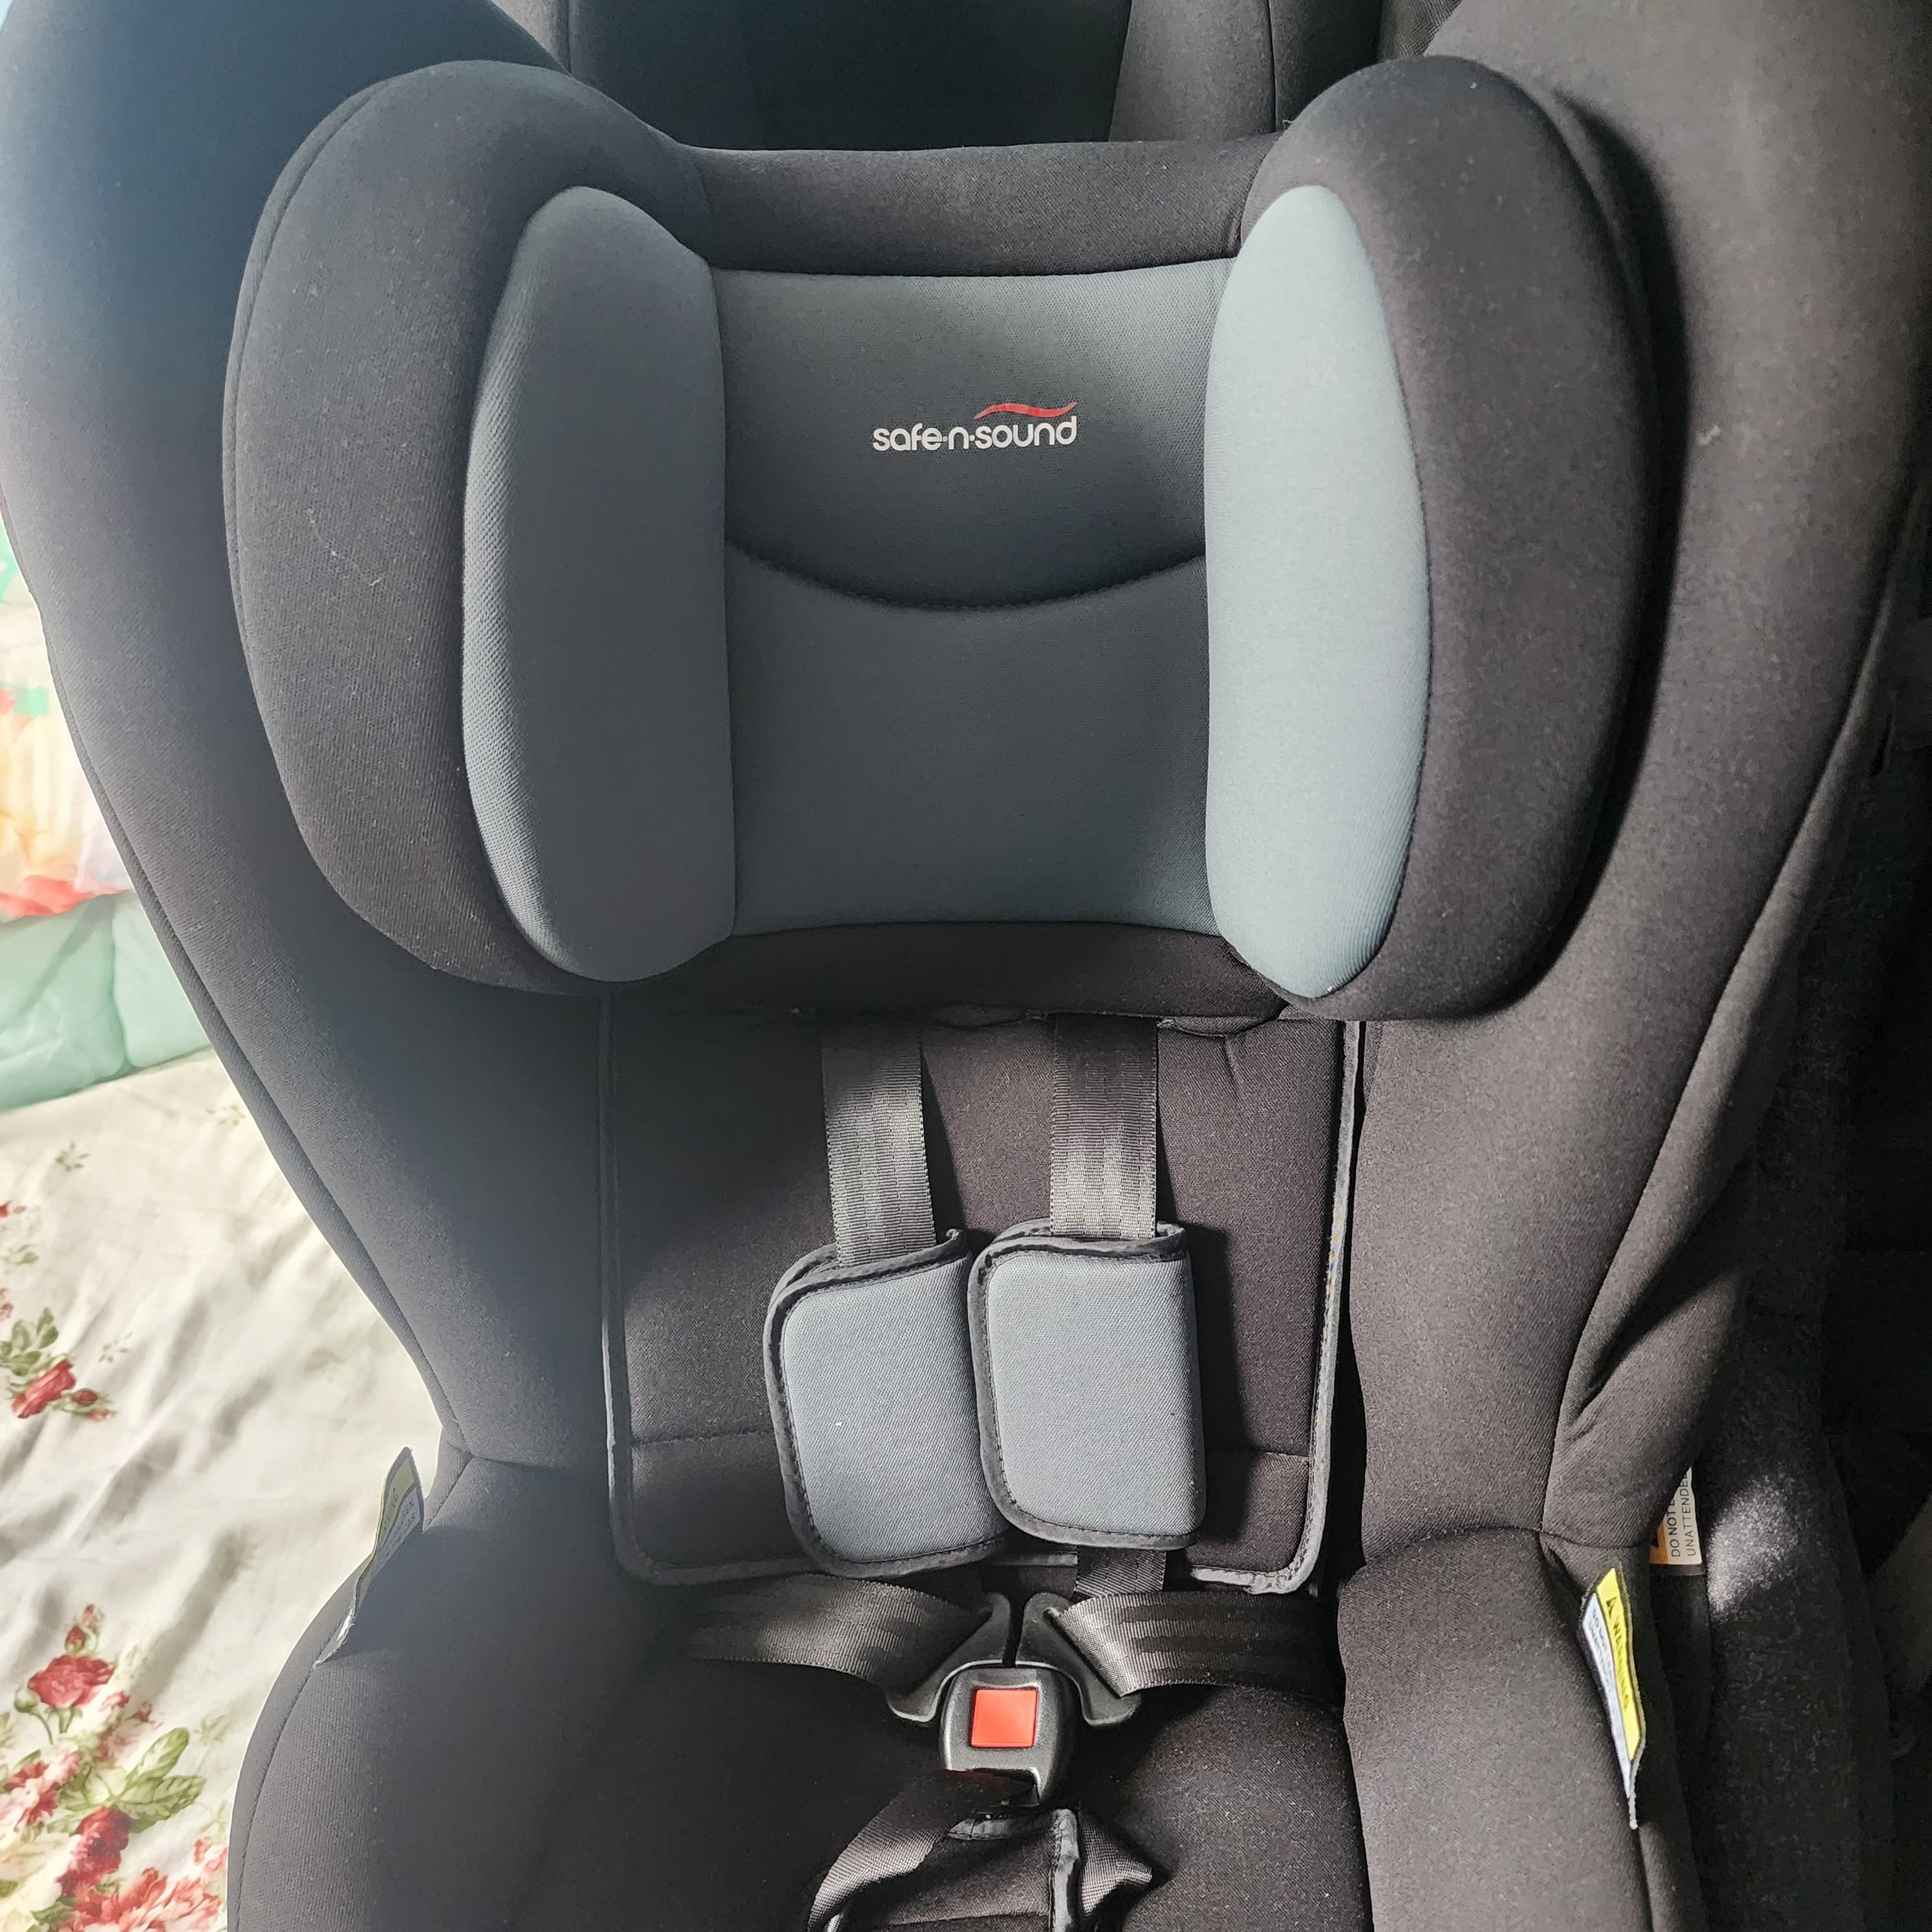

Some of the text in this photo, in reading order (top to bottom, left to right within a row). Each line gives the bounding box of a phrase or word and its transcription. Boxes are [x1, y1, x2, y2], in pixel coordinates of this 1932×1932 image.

[1666, 1510, 1678, 1536] NOT
[1679, 1474, 1697, 1556] UNATTENDE
[1669, 1538, 1681, 1557] DO
